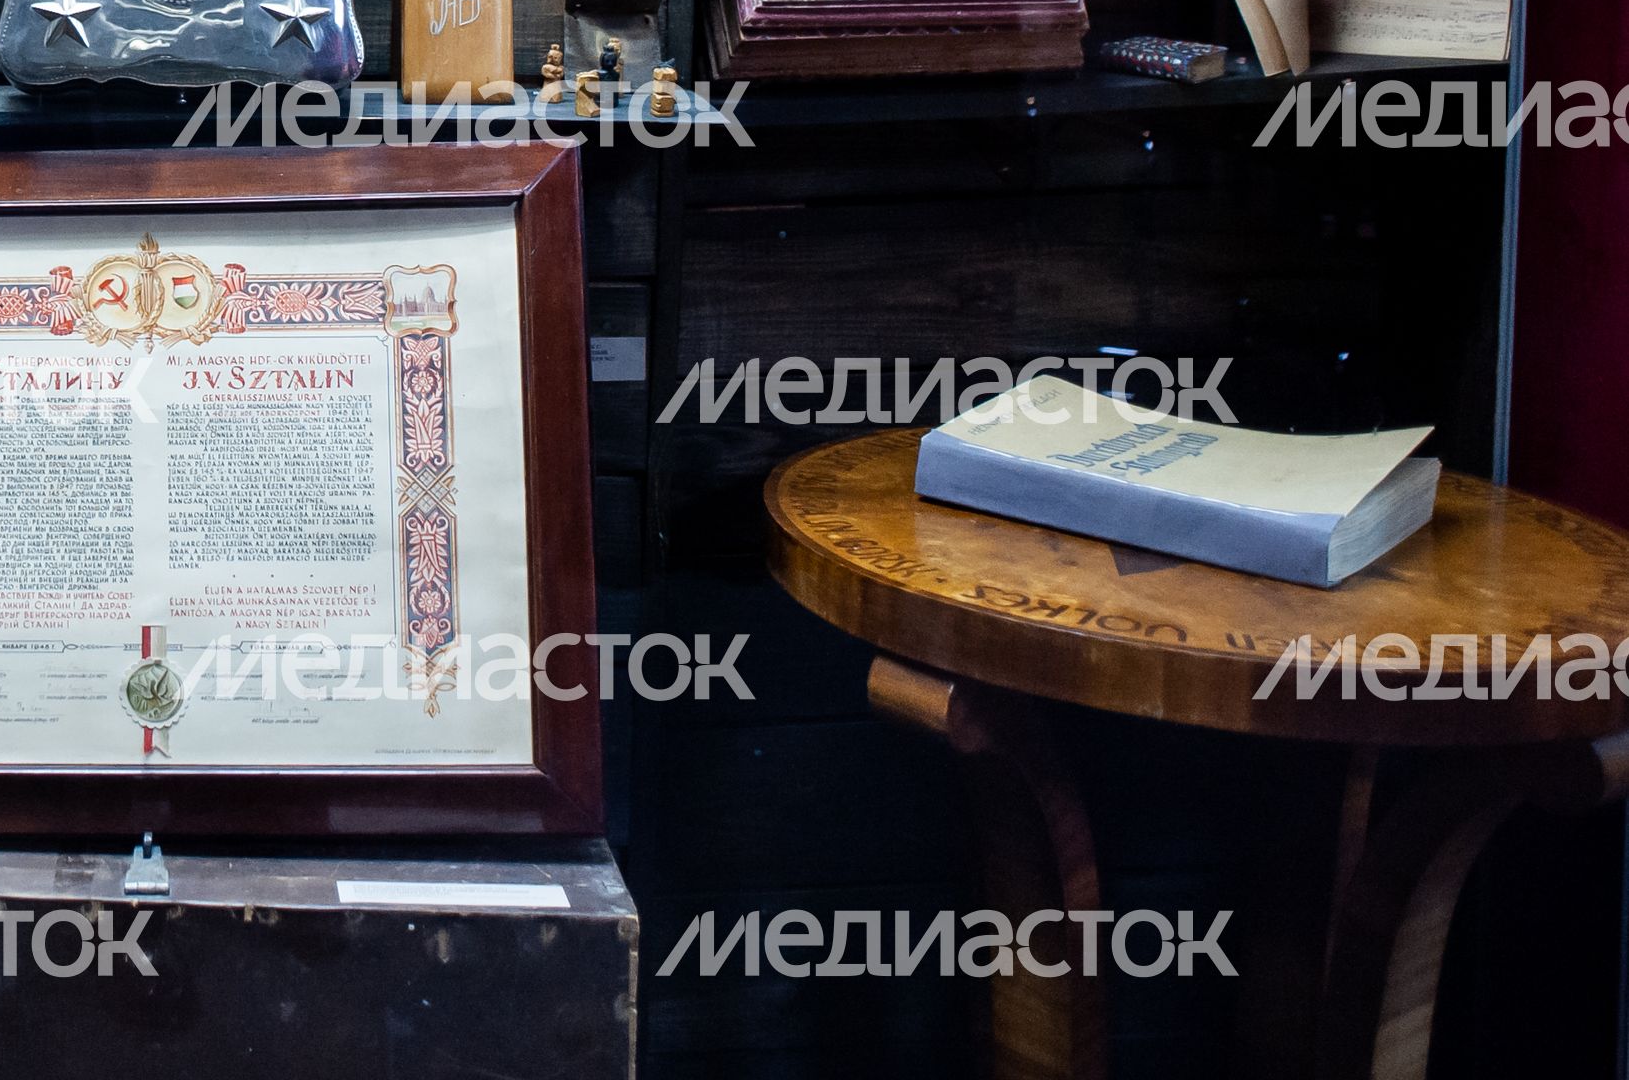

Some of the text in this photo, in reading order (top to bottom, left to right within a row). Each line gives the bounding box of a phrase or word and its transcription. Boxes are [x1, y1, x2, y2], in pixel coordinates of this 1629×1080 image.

[197, 353, 245, 366] MAGYAR
[297, 353, 371, 366] KIKÜLDÖTTEI
[227, 366, 354, 391] SZTALIN
[202, 393, 293, 402] GENERALISSZIMUSZ
[302, 585, 344, 595] SZOVJET
[206, 597, 233, 606] VILÁG
[89, 610, 131, 619] НАРОДА
[229, 608, 321, 617] MAGYAR NÉP IGAZ
[244, 619, 320, 629] NAGY SZTALIN
